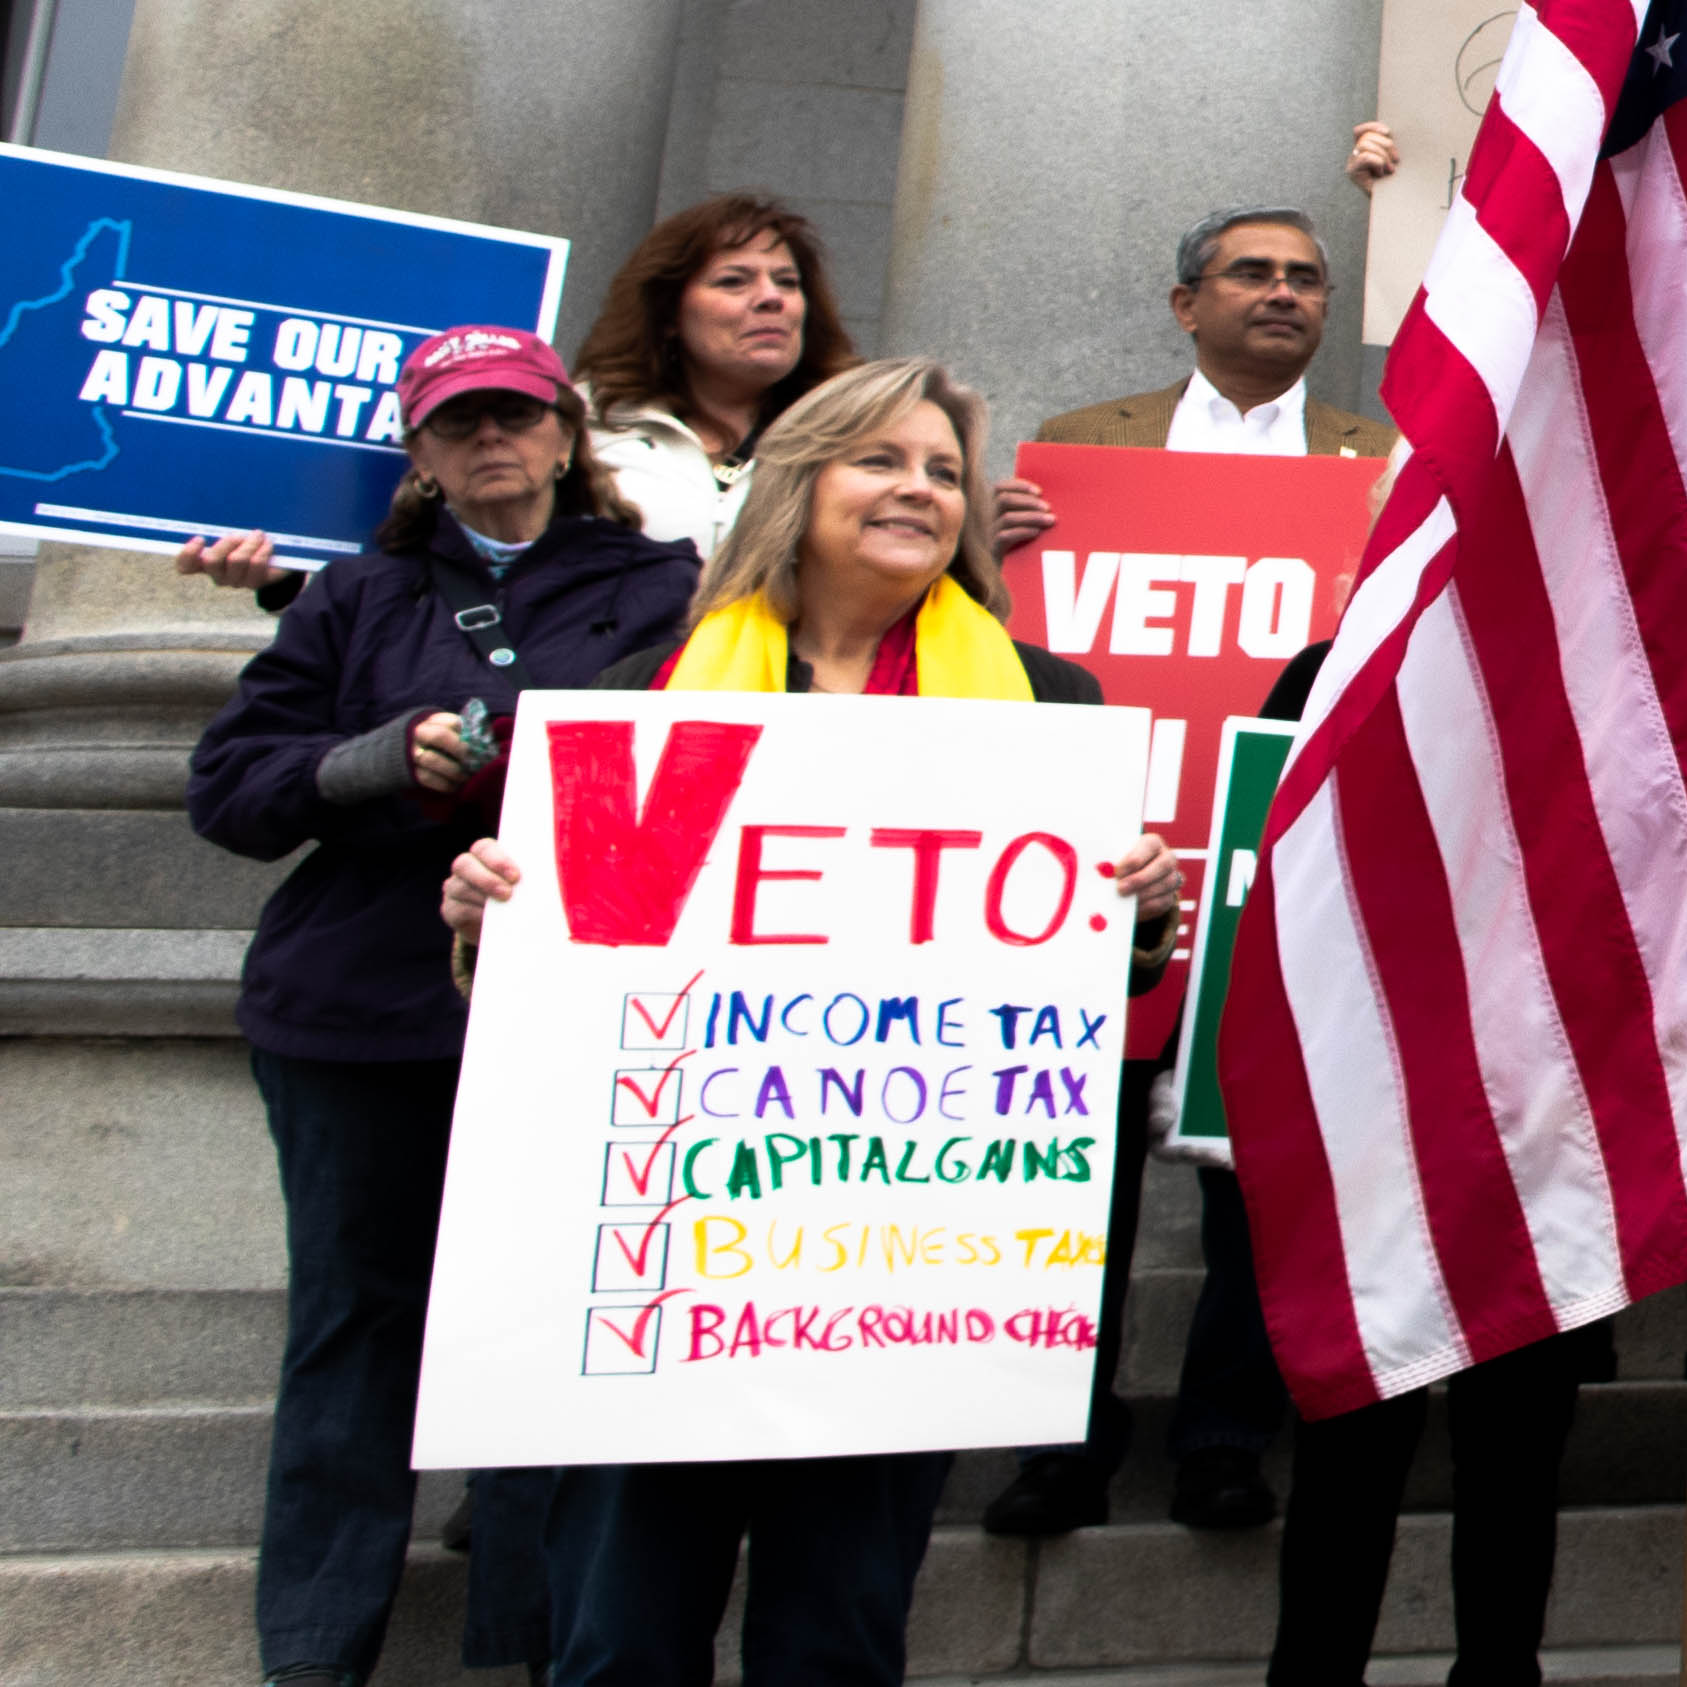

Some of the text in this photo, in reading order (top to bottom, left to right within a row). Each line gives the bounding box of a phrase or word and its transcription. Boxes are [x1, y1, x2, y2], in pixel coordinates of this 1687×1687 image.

[80, 288, 256, 364] SAVE
[272, 317, 403, 386] OUR
[1040, 548, 1316, 660] VETO
[545, 719, 1118, 948] VETO:
[703, 991, 1107, 1052] INCOME TAX
[699, 1064, 1090, 1124] CANOE TAX
[693, 1216, 1002, 1280] BUSINESS
[680, 1299, 995, 1362] BACKGROUND
